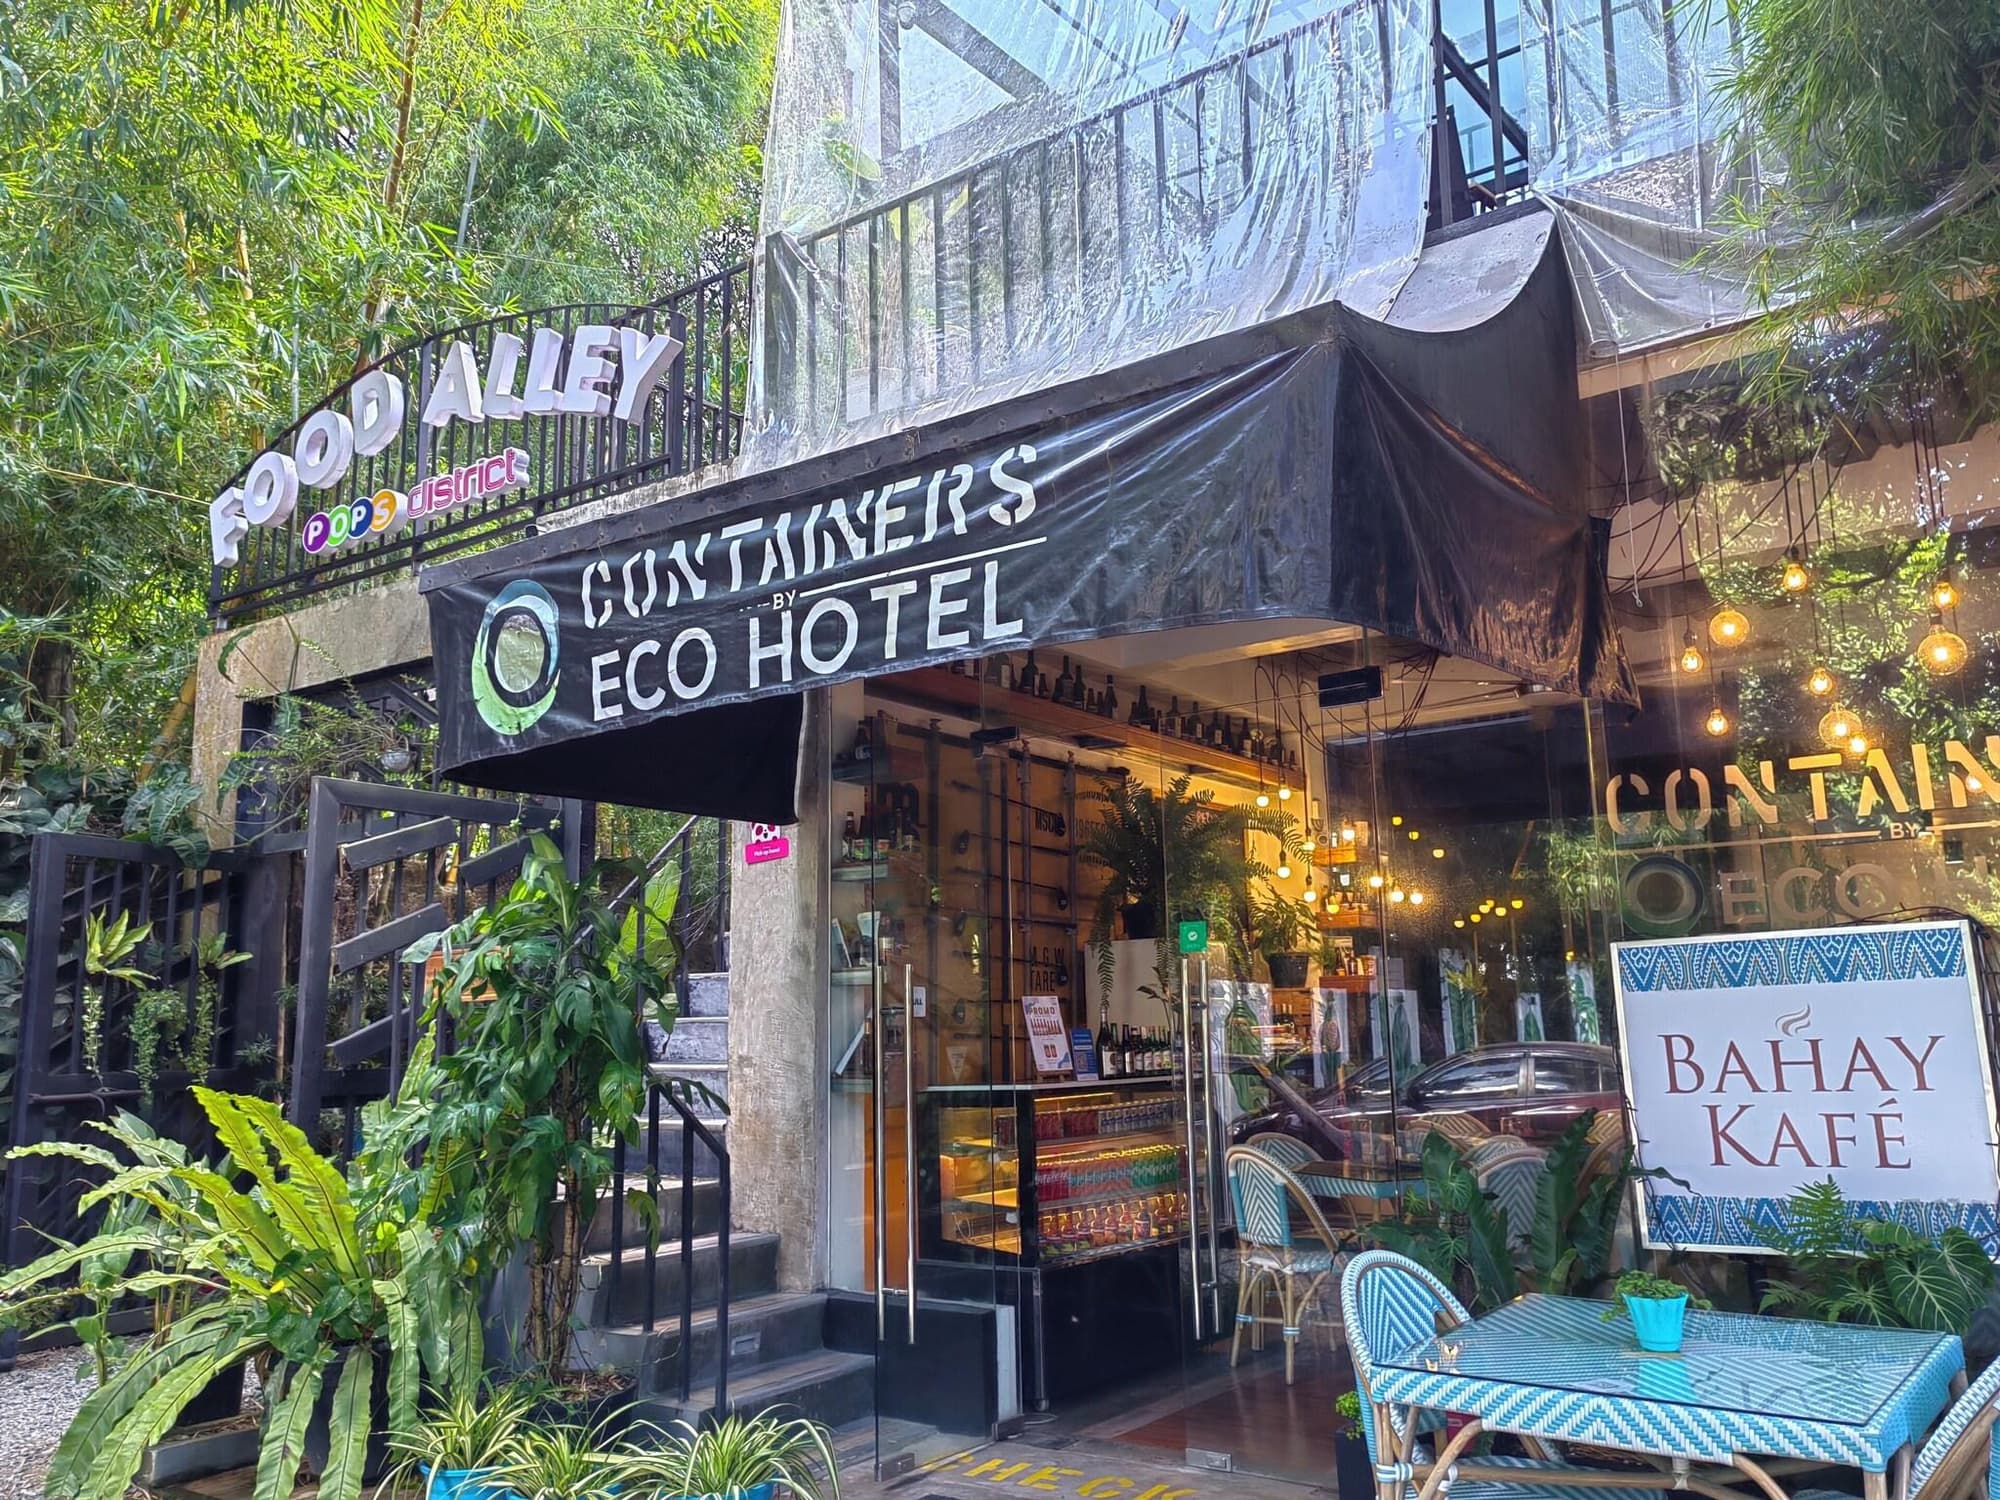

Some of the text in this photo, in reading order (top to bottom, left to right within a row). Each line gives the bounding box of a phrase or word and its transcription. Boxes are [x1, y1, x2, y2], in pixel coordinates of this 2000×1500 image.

[209, 325, 684, 567] FOOD ALLEY
[304, 447, 517, 552] POPS district
[581, 444, 1038, 629] CONTAINERS
[773, 588, 797, 611] BY
[590, 560, 1024, 722] ECO HOTEL
[1890, 823, 1918, 840] BY
[1720, 862, 1897, 925] ECO
[1658, 1034, 1945, 1094] BAHAY
[1702, 1097, 1912, 1170] KAFÉ
